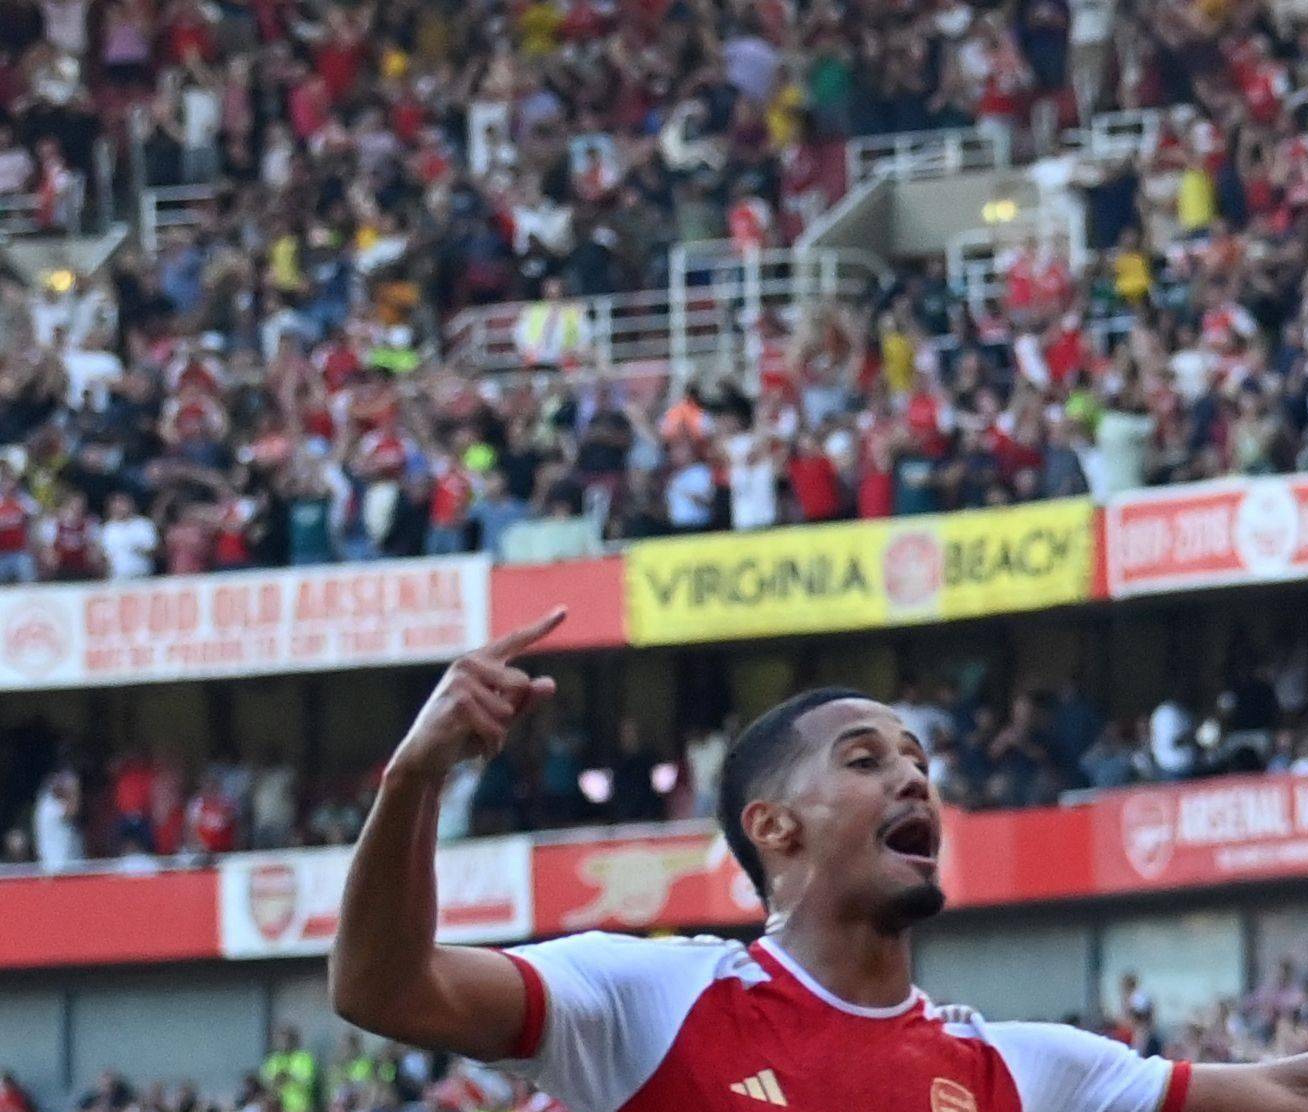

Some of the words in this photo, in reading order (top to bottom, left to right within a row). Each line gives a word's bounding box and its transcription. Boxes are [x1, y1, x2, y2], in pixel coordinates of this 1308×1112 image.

[294, 569, 465, 622] ARSENAL
[646, 551, 871, 607] VIRGINIA
[943, 526, 1073, 587] BEACH
